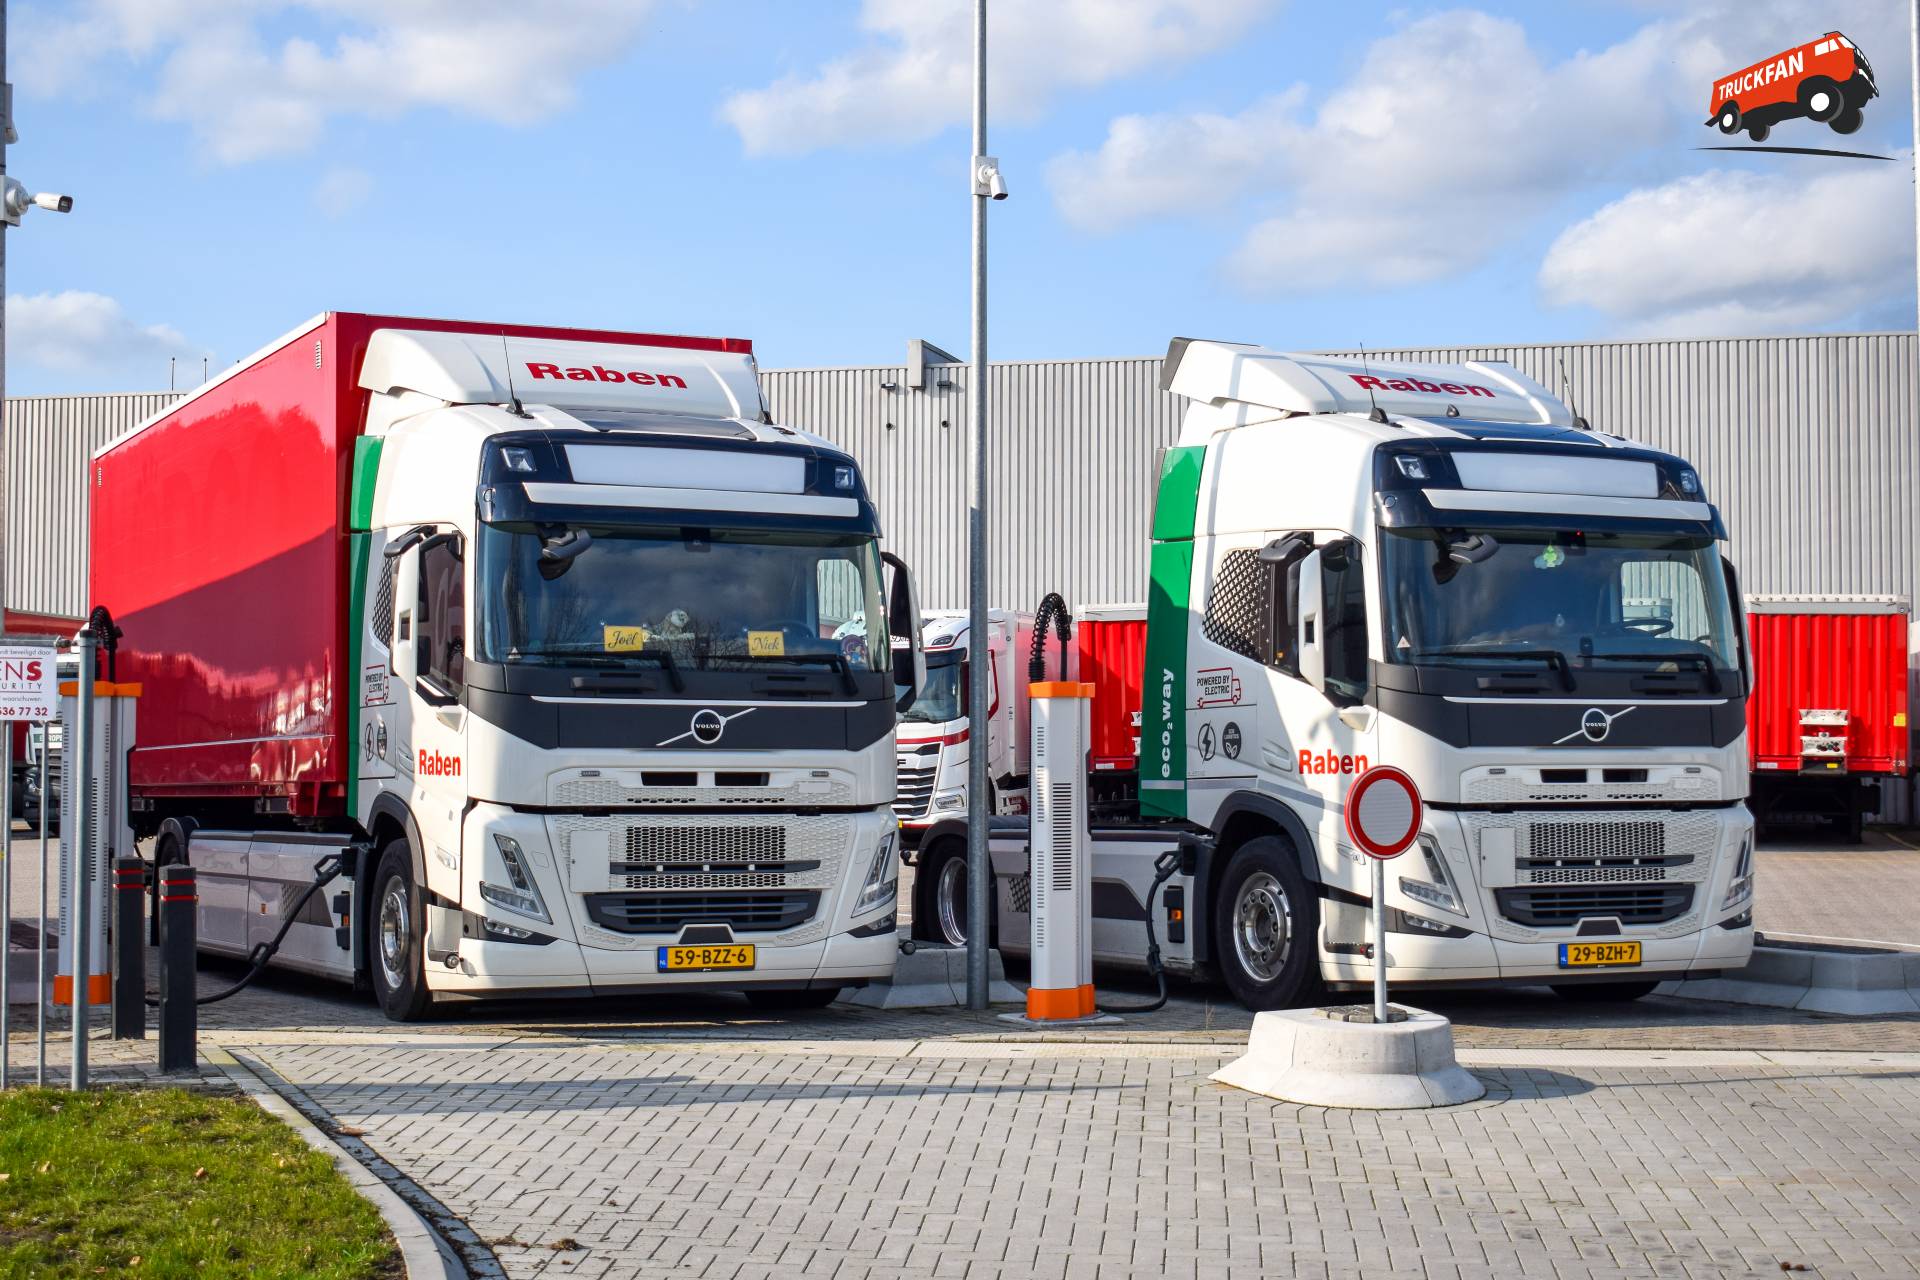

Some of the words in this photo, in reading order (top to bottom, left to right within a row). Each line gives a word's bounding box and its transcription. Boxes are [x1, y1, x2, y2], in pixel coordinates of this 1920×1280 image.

[525, 362, 688, 389] Raben
[1348, 374, 1496, 398] Raben
[608, 631, 637, 649] Joël
[0, 660, 43, 681] NS
[1196, 676, 1222, 687] POWERED
[1222, 675, 1230, 684] BY
[1204, 685, 1230, 696] ELECTRIC
[0, 706, 16, 716] 36
[18, 707, 32, 716] 77
[34, 707, 48, 717] 32
[419, 748, 461, 777] Raben
[1298, 748, 1369, 775] Raben
[674, 948, 747, 966] 59-BZZ-6
[1573, 944, 1636, 962] 29-BZH-7
